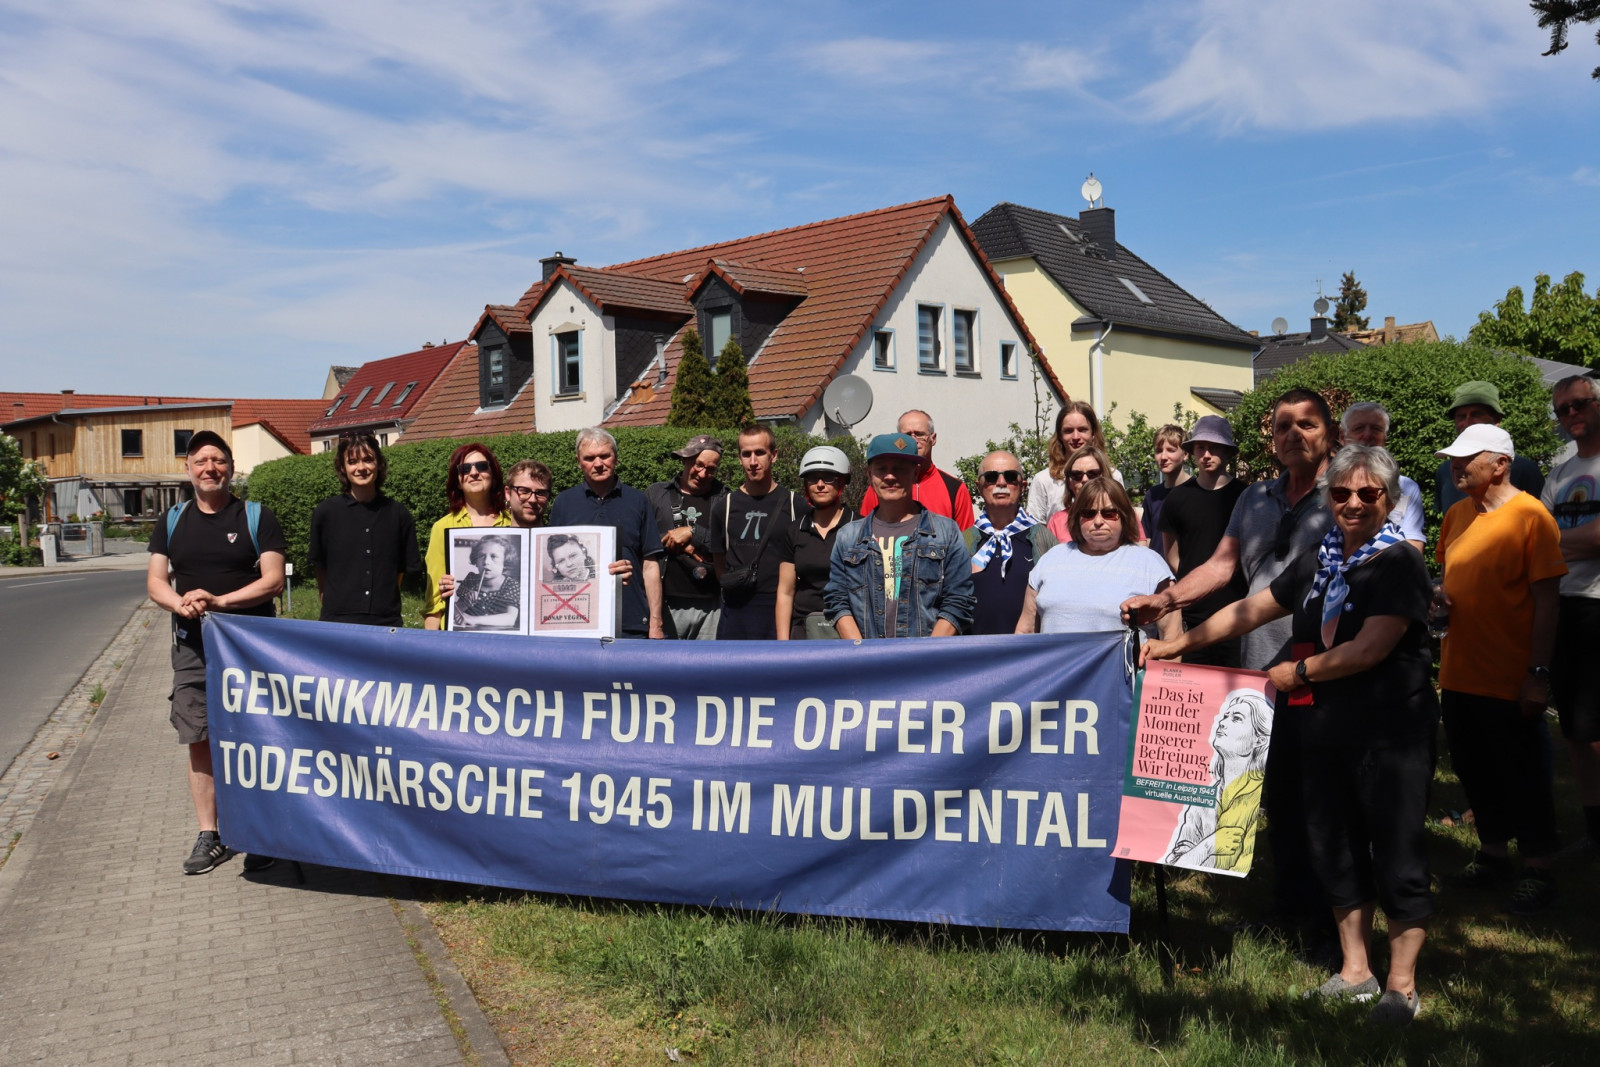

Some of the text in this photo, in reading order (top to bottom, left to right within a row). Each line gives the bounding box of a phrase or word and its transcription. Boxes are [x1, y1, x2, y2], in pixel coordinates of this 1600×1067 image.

[1152, 687, 1205, 704] „Das ist
[222, 667, 1100, 755] GEDENKMARSCH FÜR DIE OPFER DER
[1145, 703, 1200, 719] nun der
[1143, 715, 1202, 735] Moment
[1141, 733, 1196, 748] unserer
[1139, 745, 1211, 769] Befreiung.
[1138, 759, 1163, 775] Wir
[219, 740, 1107, 848] TODESMÄRSCHE 1945 IM MULDENTAL
[1136, 778, 1165, 788] BEFREIT
[1173, 783, 1198, 795] Leipzig
[1199, 786, 1215, 796] 1945
[1145, 789, 1214, 806] virtuelle Ausstellung
